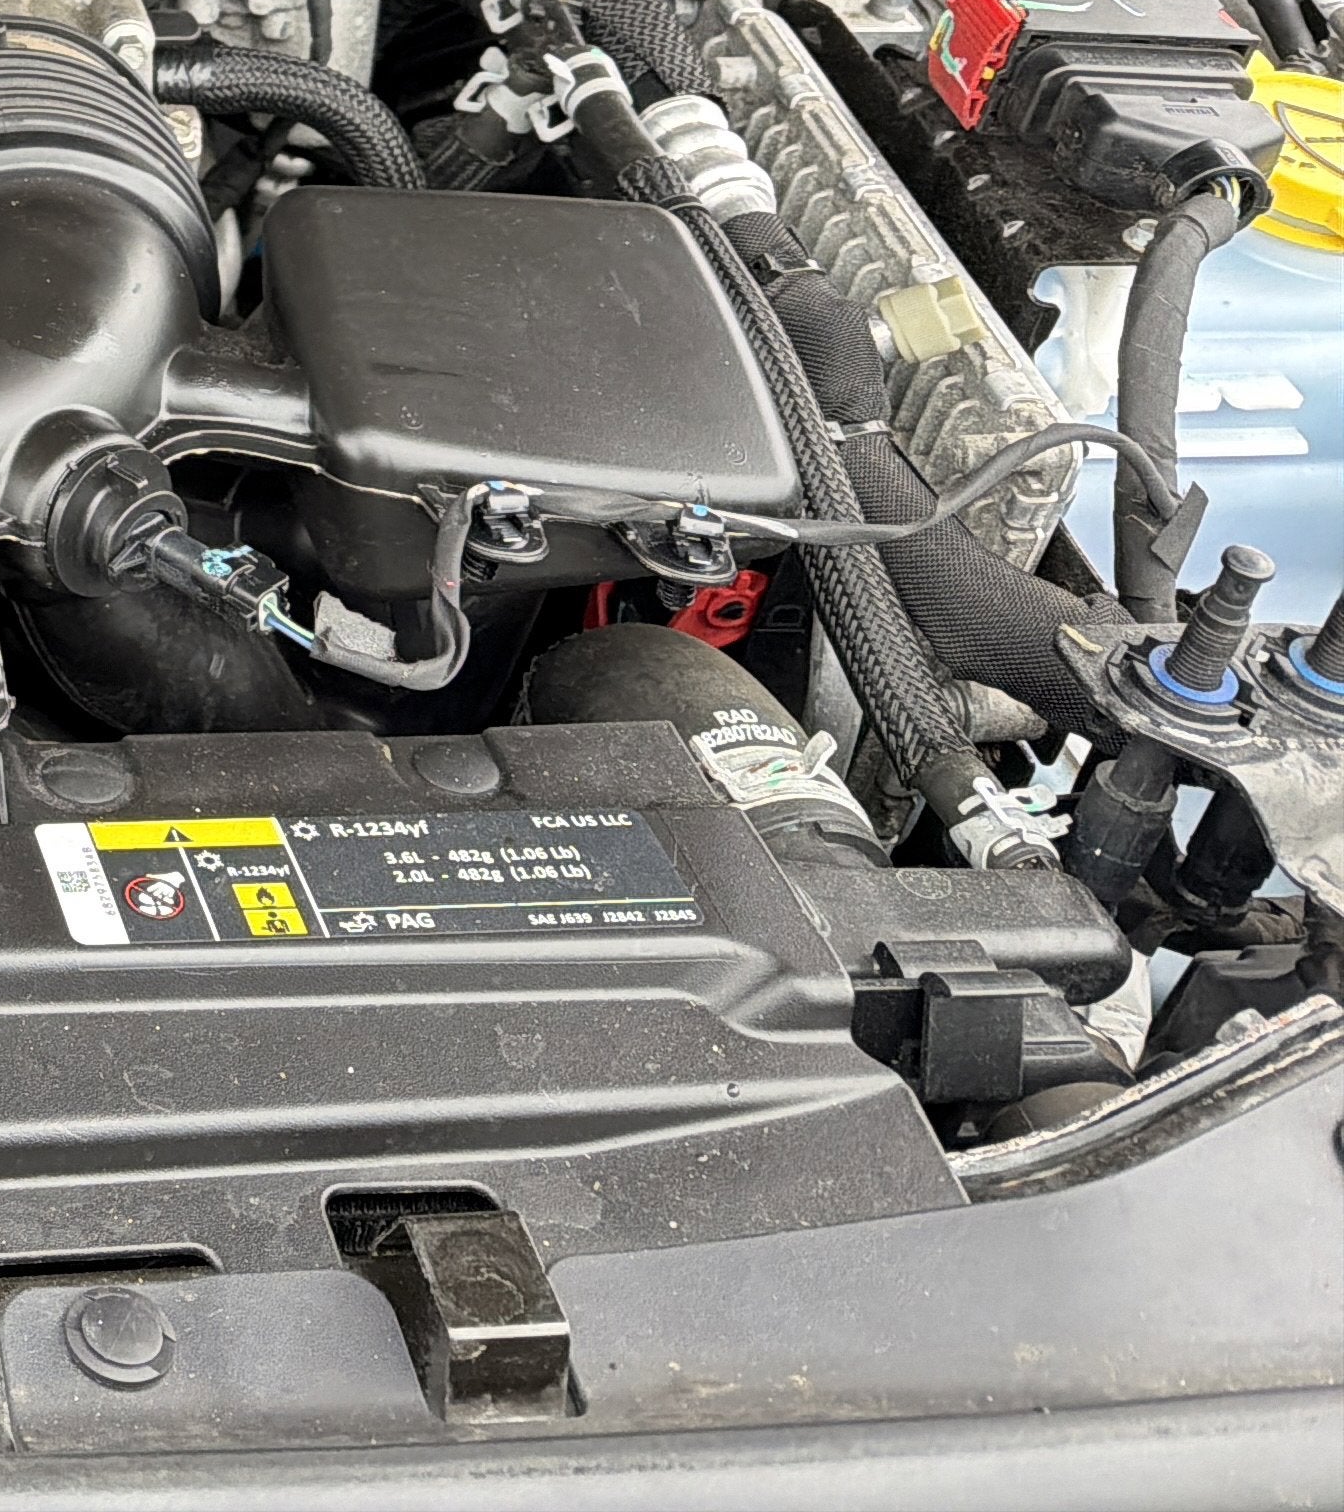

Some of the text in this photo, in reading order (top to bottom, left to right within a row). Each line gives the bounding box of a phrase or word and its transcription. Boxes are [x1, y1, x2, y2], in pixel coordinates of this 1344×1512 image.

[712, 708, 758, 727] RAD
[328, 819, 430, 838] R-1234yf
[530, 813, 633, 829] FCA US LLC
[383, 850, 425, 865] 3.6L
[448, 849, 495, 865] 482g
[500, 846, 548, 864] (1.06
[548, 844, 581, 862] Lb)
[226, 864, 291, 878] R-1234yf
[392, 869, 434, 884] 2.0L
[457, 867, 505, 883] 482g
[509, 865, 559, 883] (1.06
[559, 863, 592, 881] Lb)
[384, 912, 437, 930] PAG
[527, 913, 558, 927] SAE
